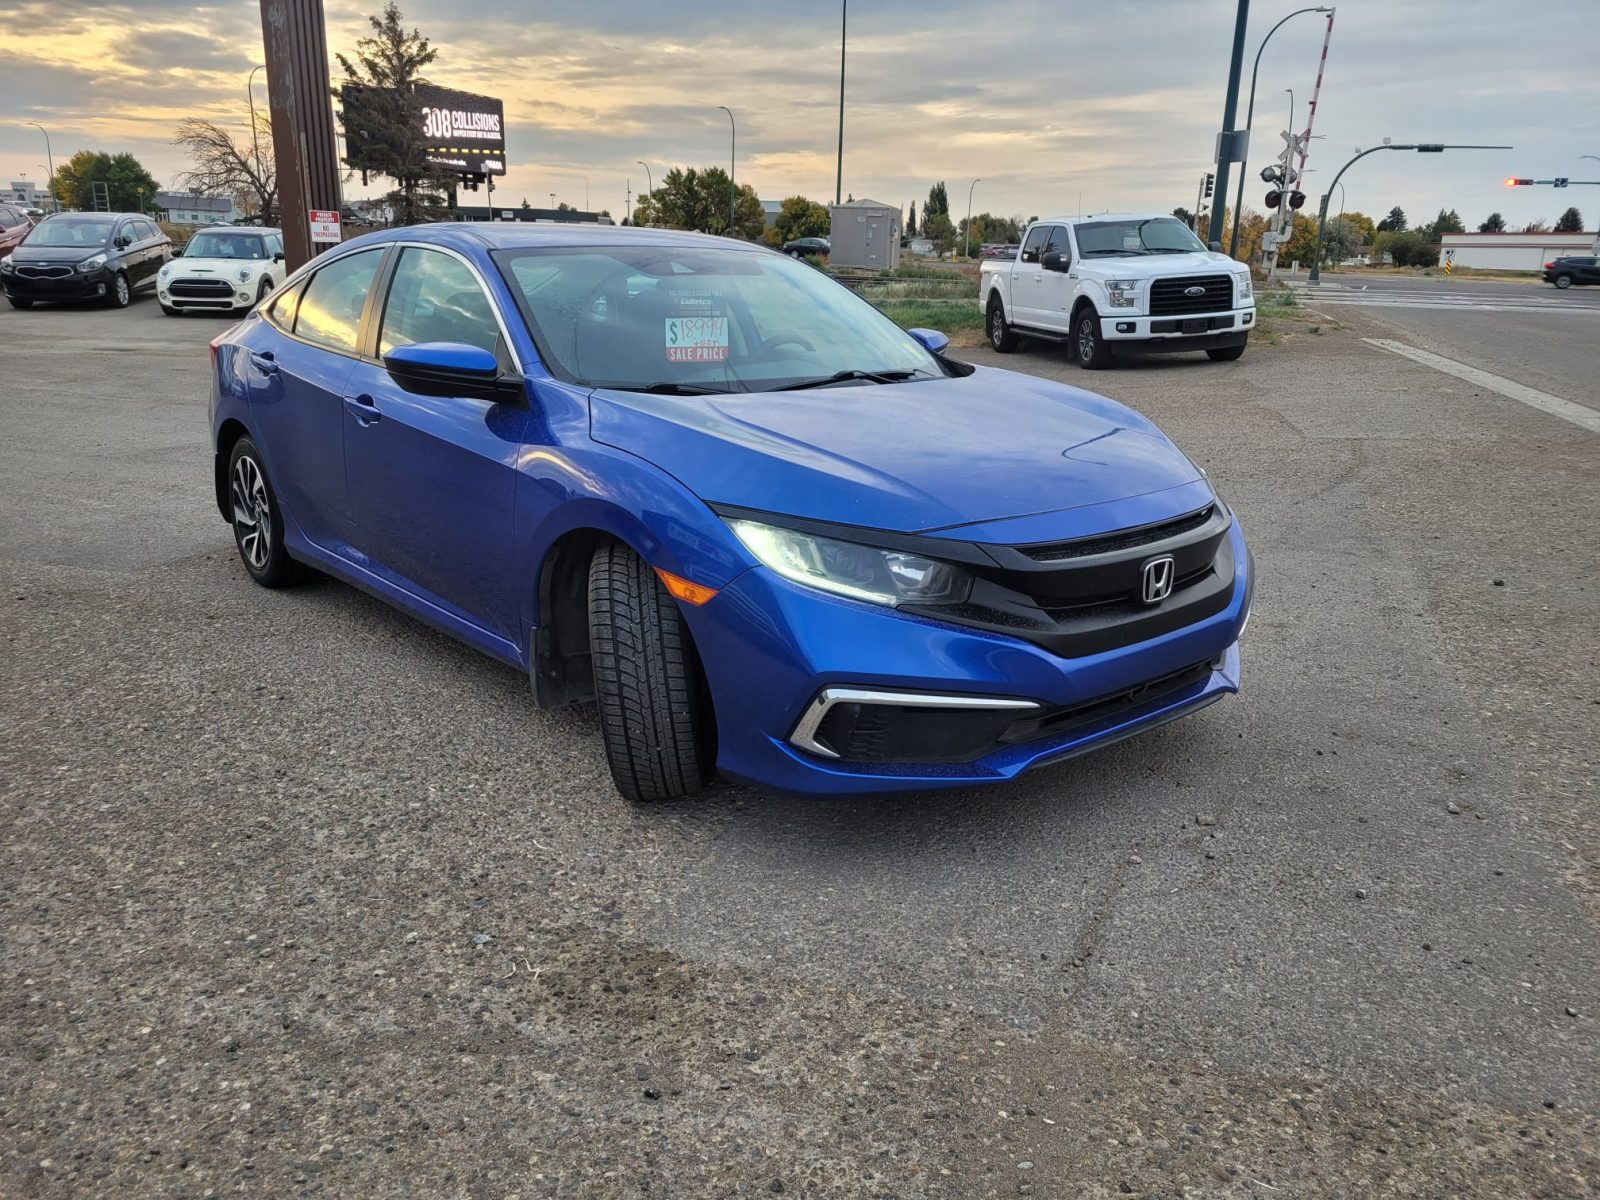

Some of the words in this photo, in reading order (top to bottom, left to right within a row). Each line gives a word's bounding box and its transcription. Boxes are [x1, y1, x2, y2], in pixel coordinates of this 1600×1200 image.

[422, 107, 452, 138] 308
[452, 111, 500, 131] COLLISIONS
[670, 348, 693, 360] SALE
[696, 348, 724, 360] PRICE
